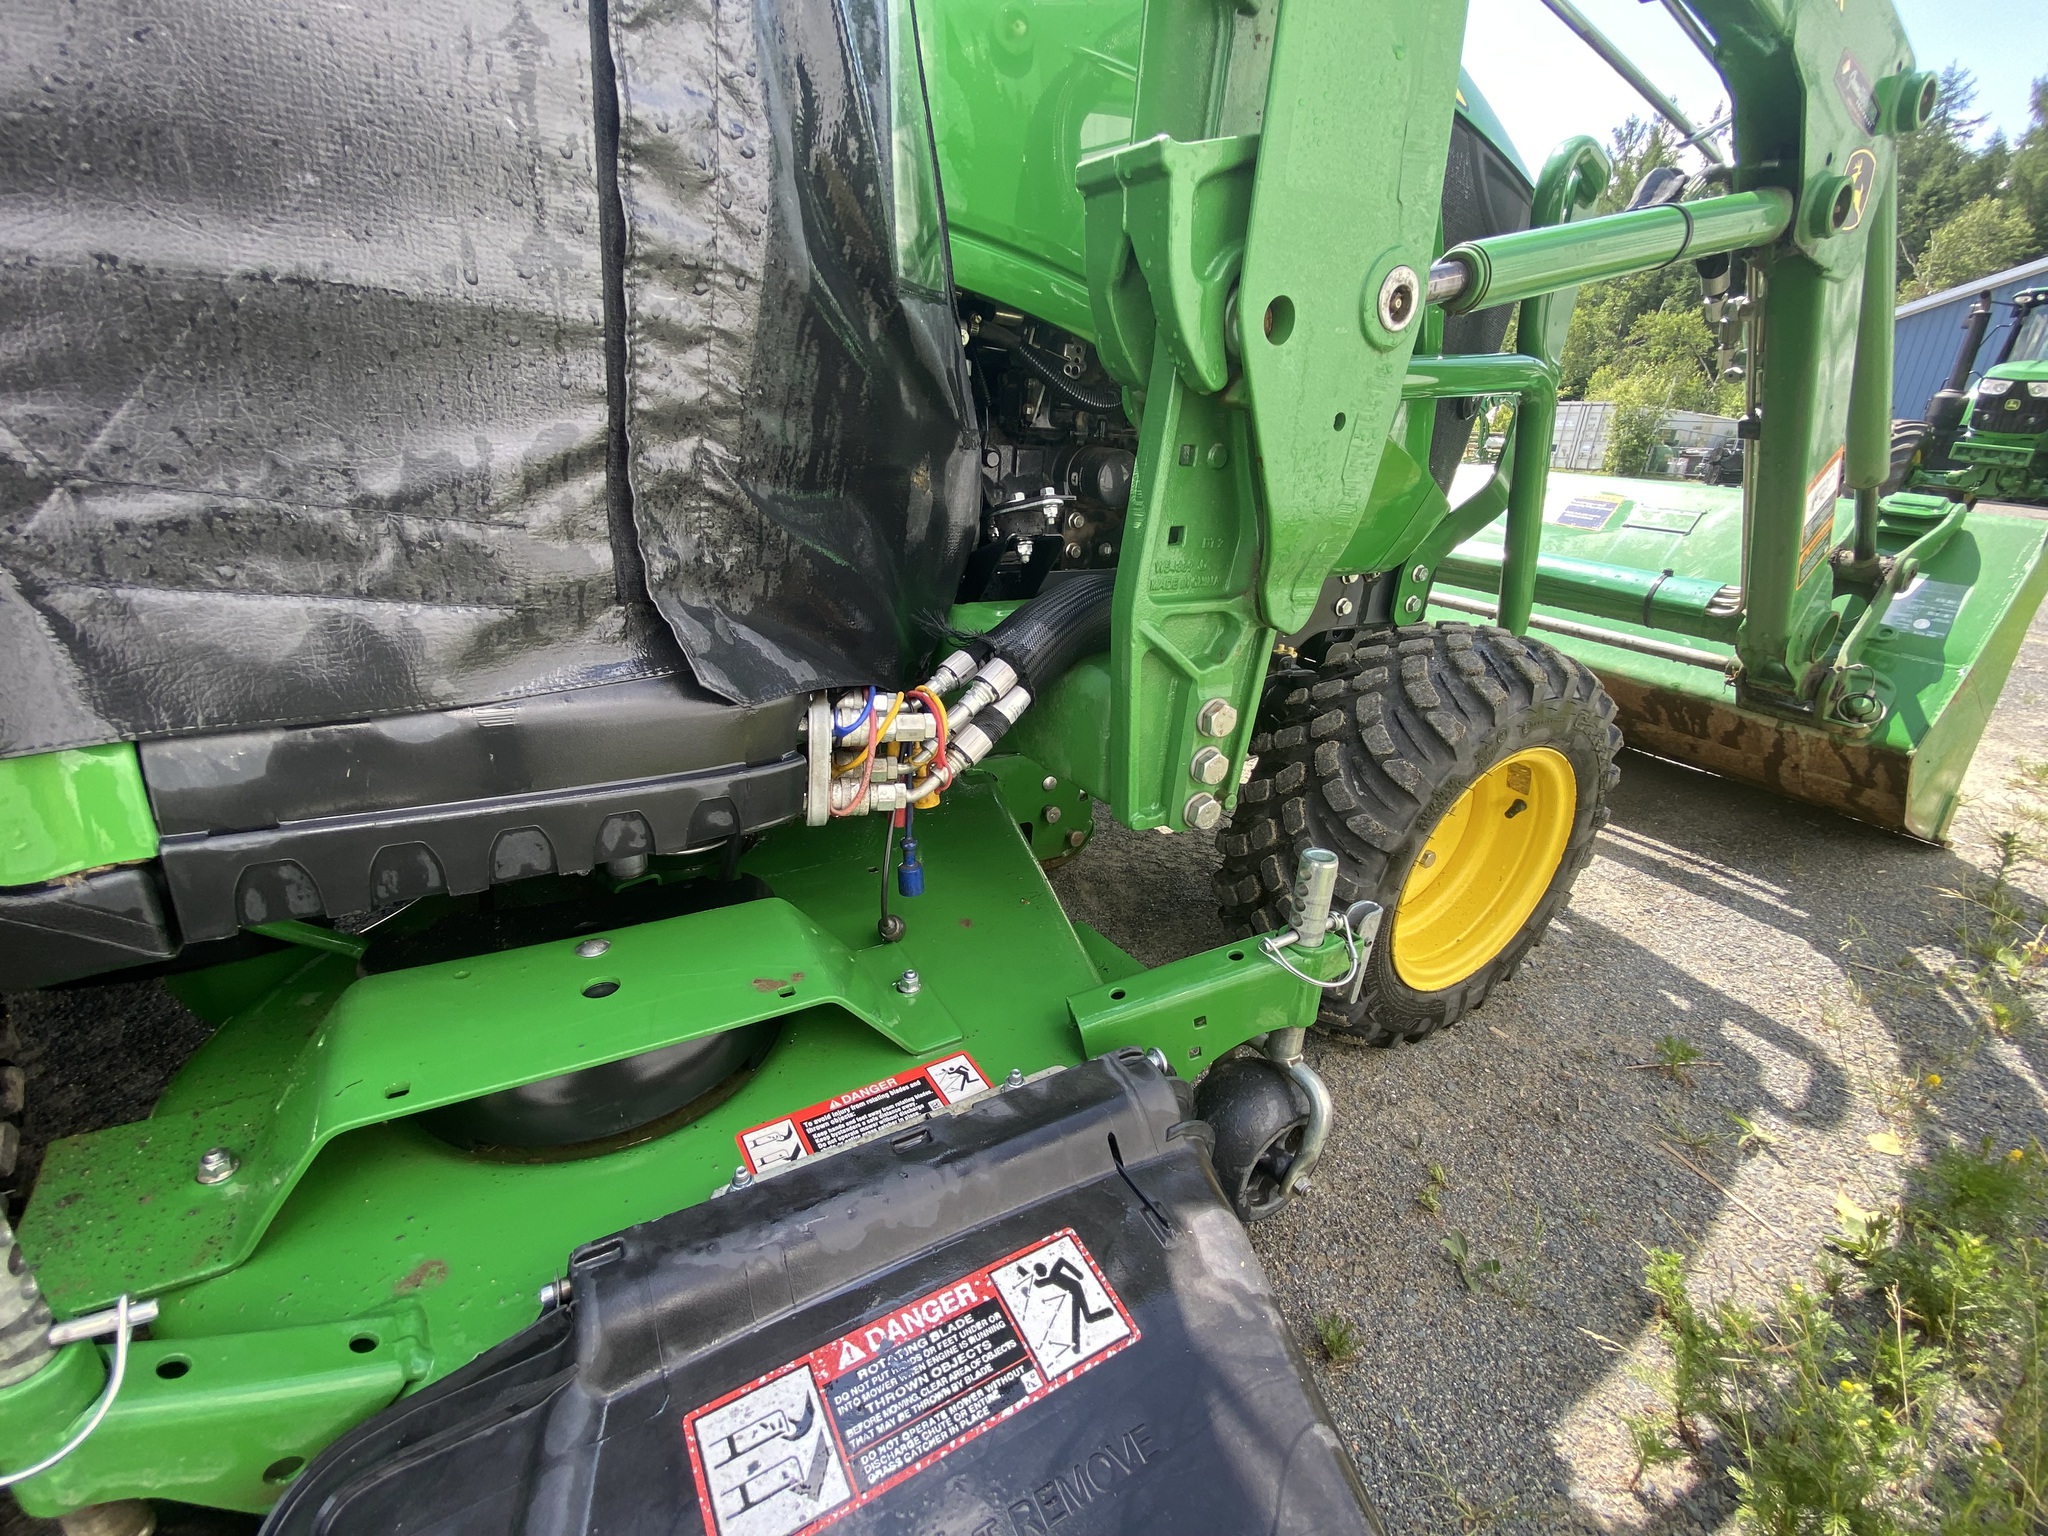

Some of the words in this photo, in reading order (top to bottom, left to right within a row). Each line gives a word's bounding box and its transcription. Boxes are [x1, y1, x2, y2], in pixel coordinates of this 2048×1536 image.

[812, 1130, 828, 1139] Keep
[828, 1123, 845, 1133] hands
[845, 1118, 857, 1126] and
[856, 1114, 868, 1122] feet
[867, 1109, 882, 1118] away
[881, 1104, 895, 1112] from
[895, 1096, 915, 1107] rotating
[813, 1113, 831, 1125] avoid
[831, 1107, 850, 1118] injury
[851, 1101, 866, 1110] from
[866, 1092, 890, 1105] rotating
[889, 1084, 909, 1096] blades
[910, 1080, 921, 1088] and
[840, 1077, 898, 1105] DANGER
[806, 1121, 830, 1134] thrown
[814, 1135, 831, 1144] Keep
[830, 1123, 861, 1138] bystanders
[866, 1116, 879, 1124] safe
[879, 1107, 901, 1119] distance
[827, 1137, 838, 1146] not
[837, 1129, 859, 1141] operate
[859, 1121, 879, 1132] mower
[878, 1113, 899, 1124] without
[898, 1104, 925, 1116] discharge
[863, 1281, 978, 1352] DANGER
[928, 1312, 974, 1343] BLADE
[833, 1391, 850, 1405] DO
[849, 1380, 871, 1397] NOT
[870, 1370, 891, 1385] PUT
[922, 1345, 937, 1358] OR
[936, 1333, 959, 1351] FEET
[958, 1318, 988, 1339] UNDER
[987, 1311, 1002, 1324] OR
[836, 1396, 861, 1415] INTO
[860, 1376, 899, 1402] MOWER
[925, 1345, 959, 1367] ENGINE
[958, 1339, 969, 1350] IS
[967, 1319, 1006, 1345] RUNNING
[844, 1412, 883, 1438] BEFORE
[919, 1376, 948, 1397] CLEAR
[946, 1363, 971, 1382] AREA
[968, 1357, 982, 1369] OF
[980, 1338, 1017, 1363] OBJECTS
[864, 1373, 930, 1414] THROWN
[929, 1338, 993, 1379] OBJECTS
[848, 1428, 877, 1449] THAT
[875, 1417, 897, 1434] MAY
[896, 1409, 911, 1422] BE
[911, 1386, 952, 1414] THROWN
[949, 1379, 965, 1392] BY
[963, 1362, 994, 1385] BLADE
[859, 1449, 878, 1465] DO
[875, 1435, 902, 1455] NOT
[900, 1409, 948, 1441] OPERATE
[947, 1388, 985, 1414] MOWER
[983, 1364, 1026, 1393] WITHOUT
[902, 1430, 950, 1462] CATCHER
[948, 1424, 960, 1436] IN
[958, 1406, 991, 1429] PLACE
[863, 1435, 922, 1474] DISCHARGE
[920, 1417, 953, 1440] CHUTE
[952, 1408, 968, 1422] OR
